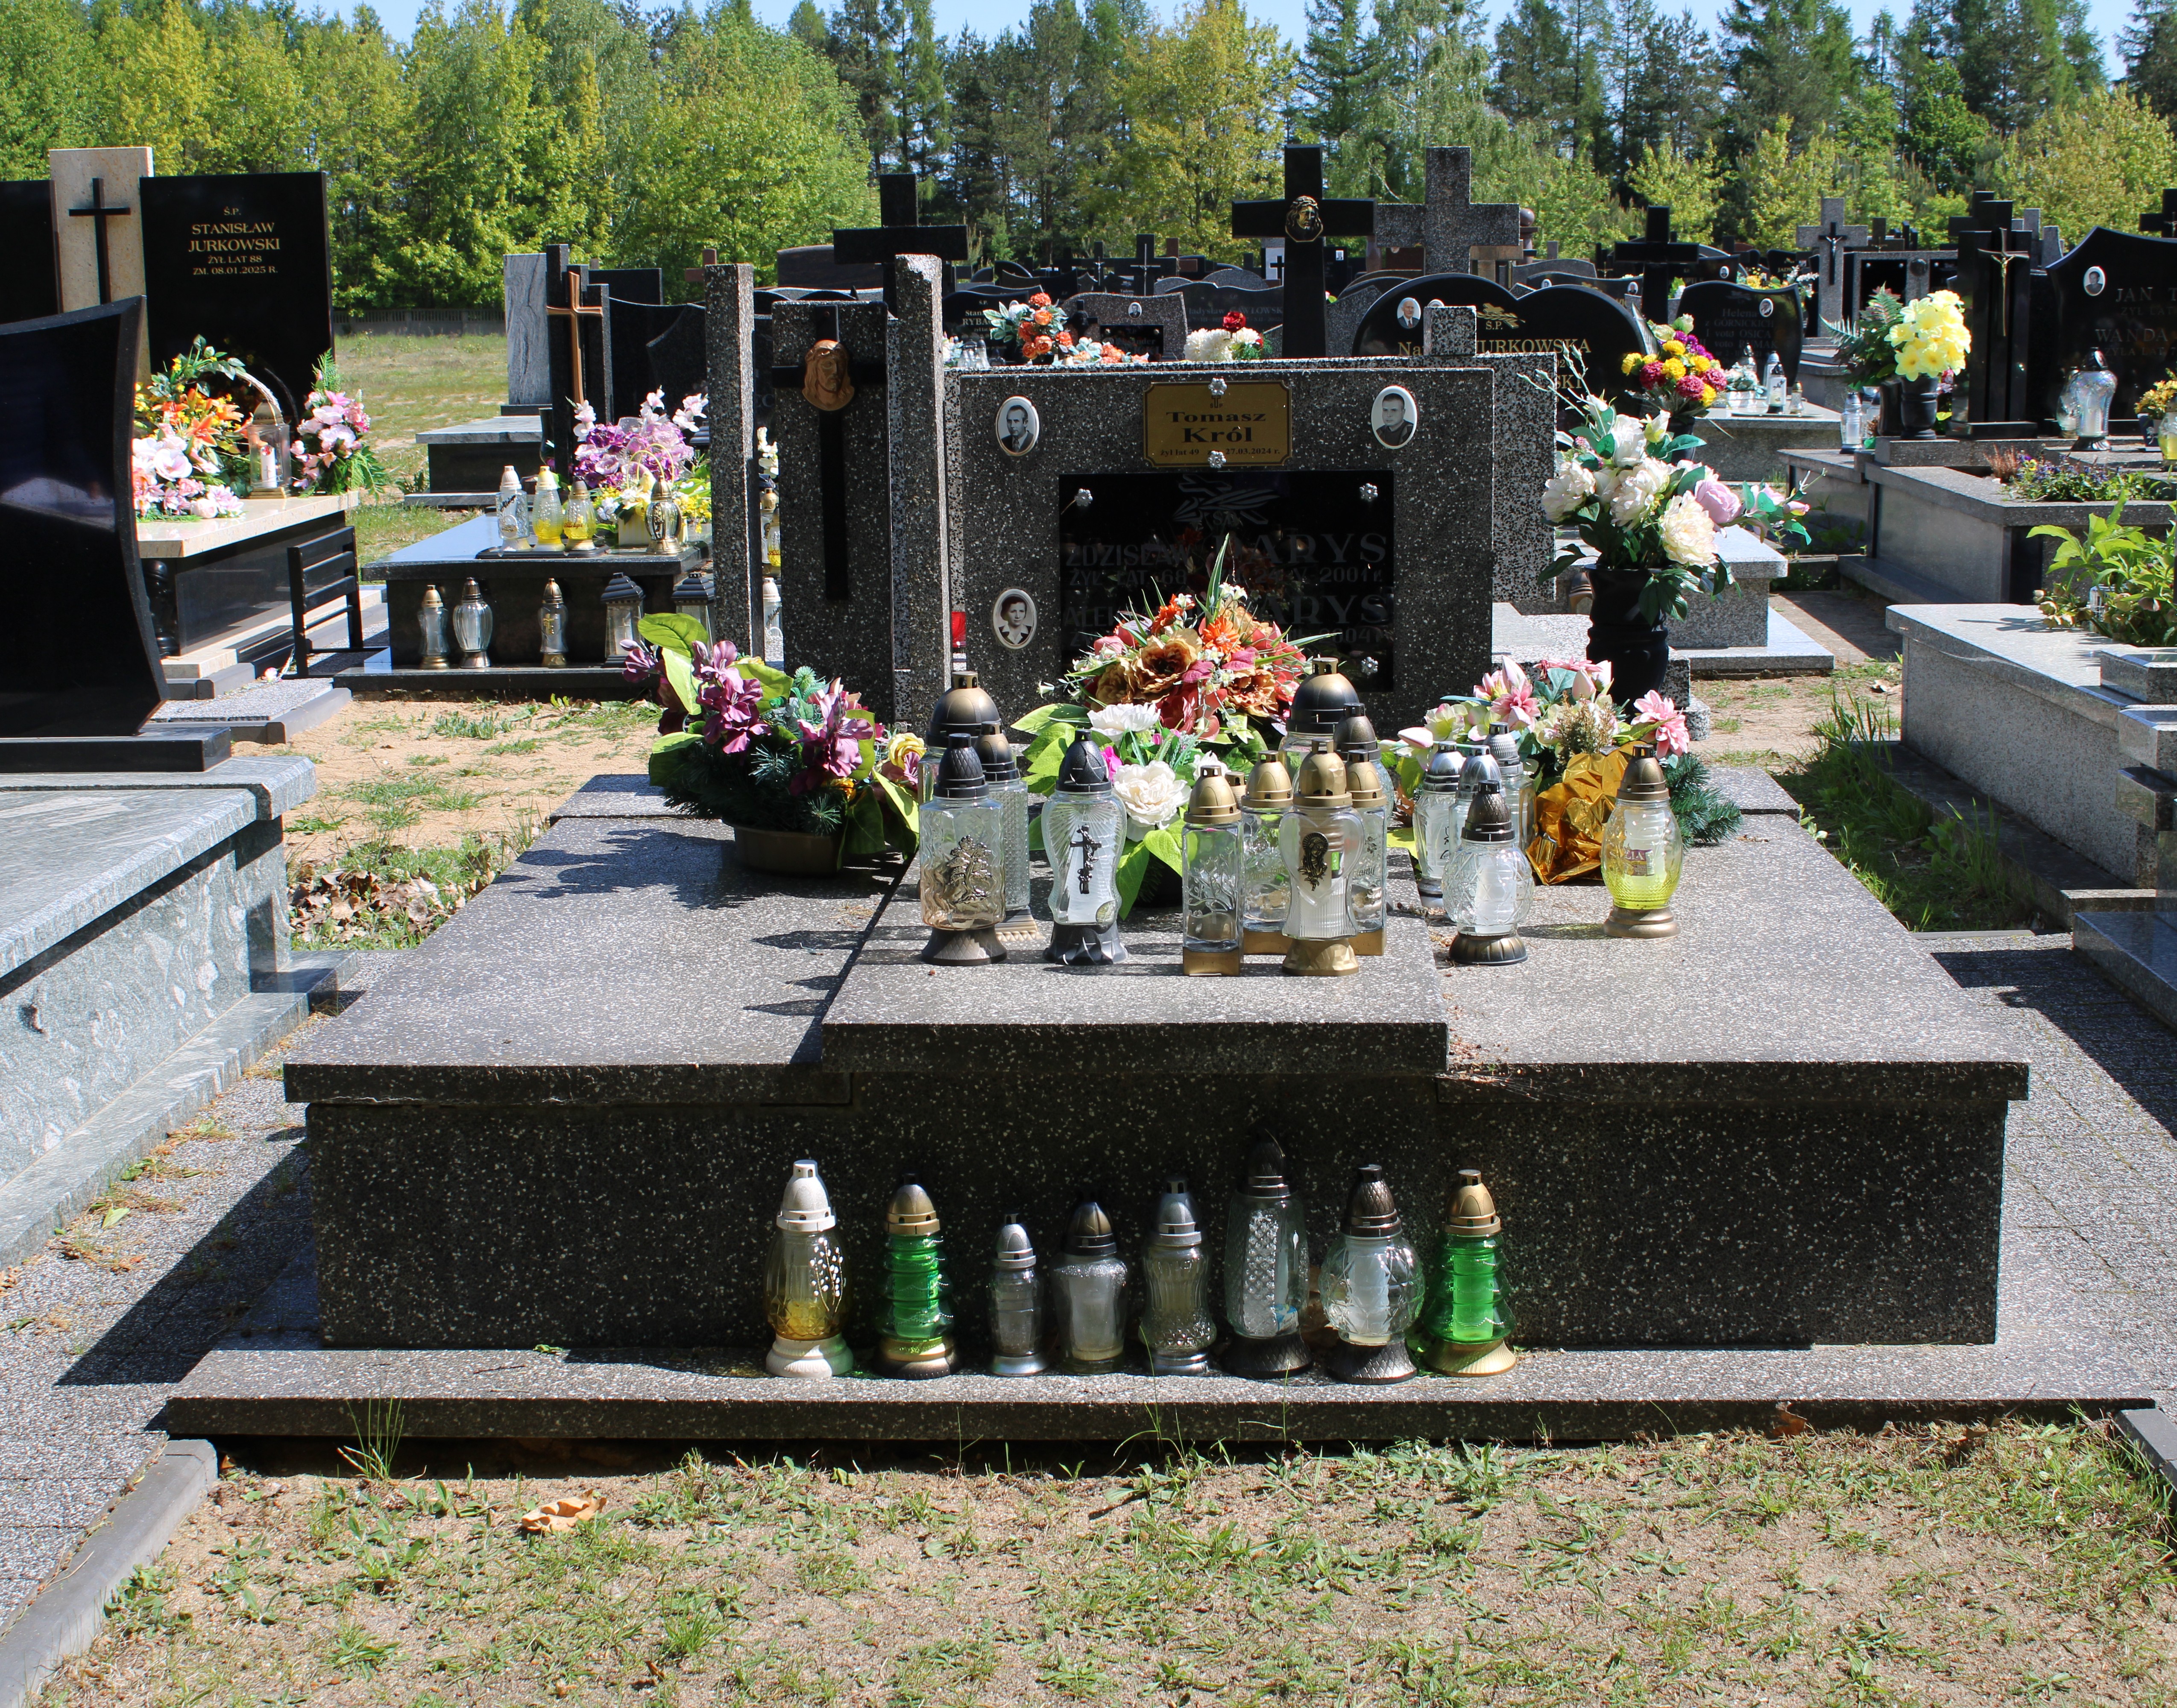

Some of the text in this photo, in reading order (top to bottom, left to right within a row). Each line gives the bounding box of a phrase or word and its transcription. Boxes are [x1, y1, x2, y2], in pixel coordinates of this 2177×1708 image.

[192, 222, 275, 234] STANISŁAW
[188, 238, 280, 252] JURKOWSKI
[229, 255, 247, 263] LAT
[211, 266, 266, 275] 08.01.2025
[2115, 287, 2154, 302] JAN
[1722, 308, 1758, 317] Helena
[2095, 328, 2168, 342] WANDA
[1166, 412, 1266, 423] Tomasz
[1181, 427, 1253, 443] Król
[1066, 544, 1192, 566] ZDZISŁAW
[1117, 570, 1149, 585] LAT
[1162, 569, 1187, 585] 68
